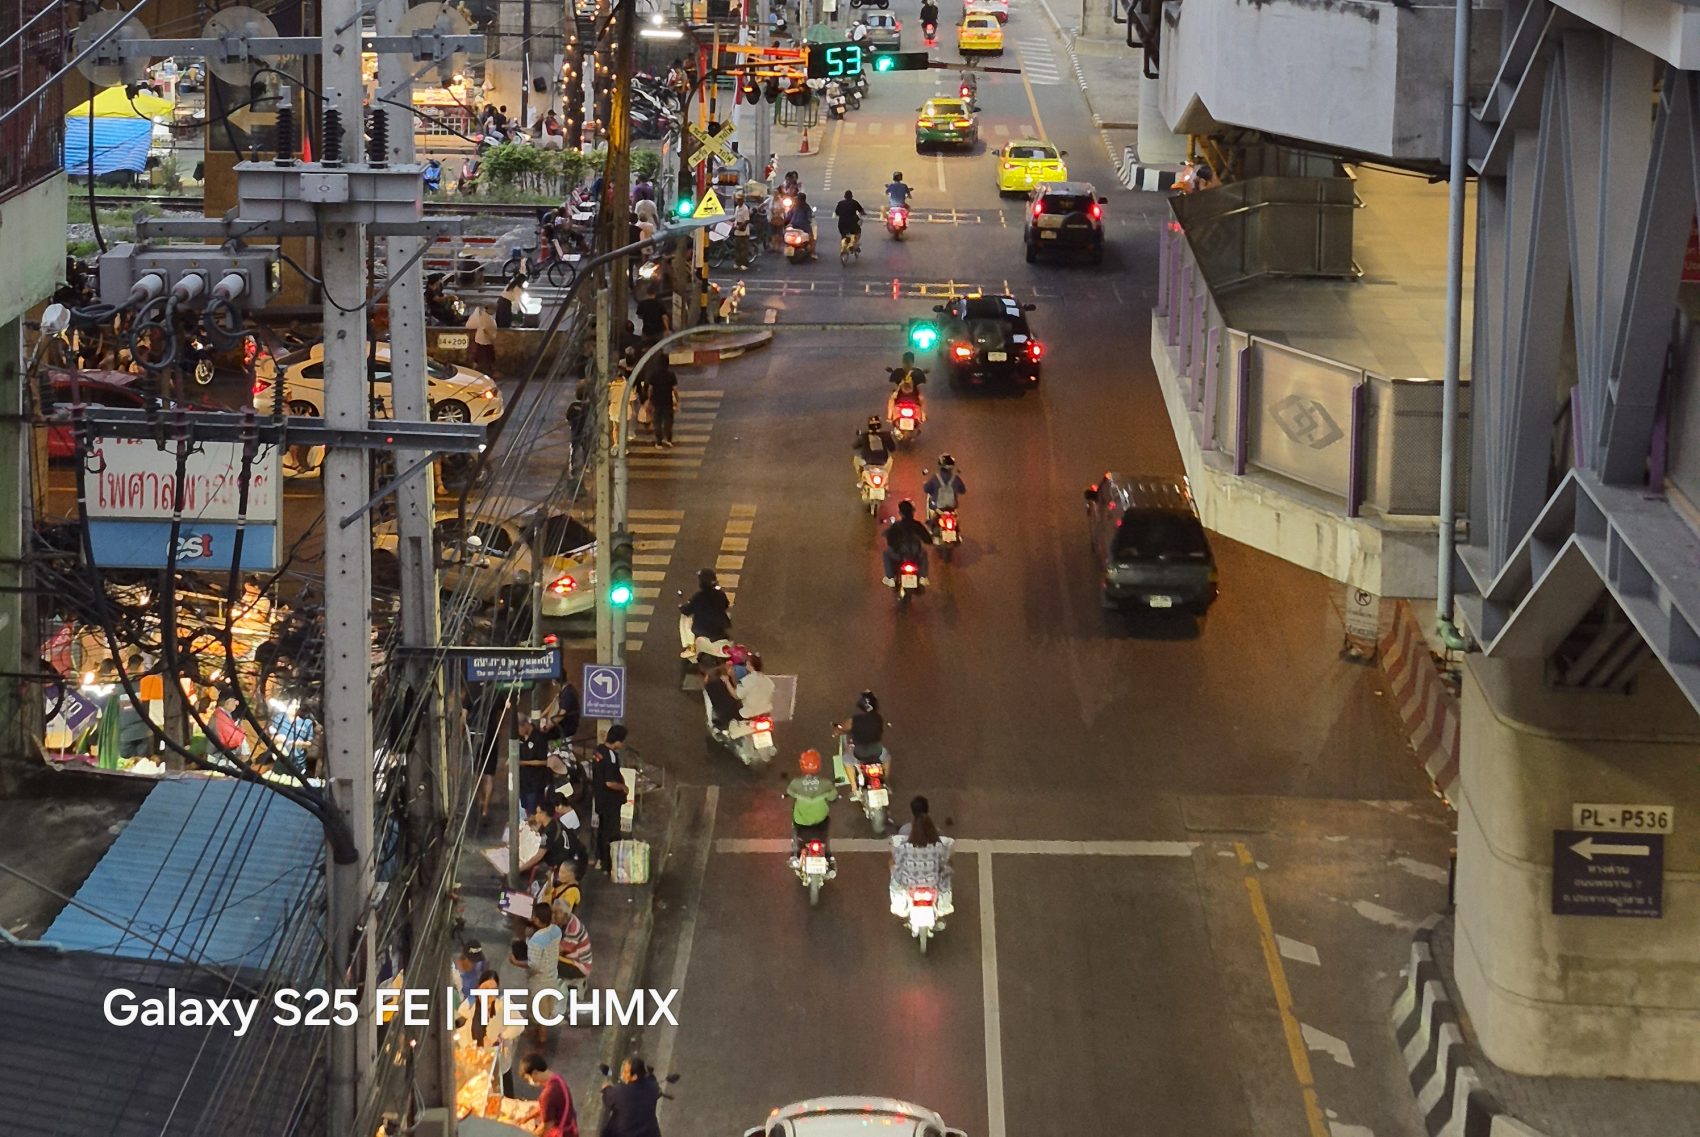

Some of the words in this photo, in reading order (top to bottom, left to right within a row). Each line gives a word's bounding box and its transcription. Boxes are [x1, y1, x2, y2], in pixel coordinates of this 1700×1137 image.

[826, 46, 861, 76] 53
[1580, 809, 1605, 827] PL
[1621, 810, 1669, 829] P536
